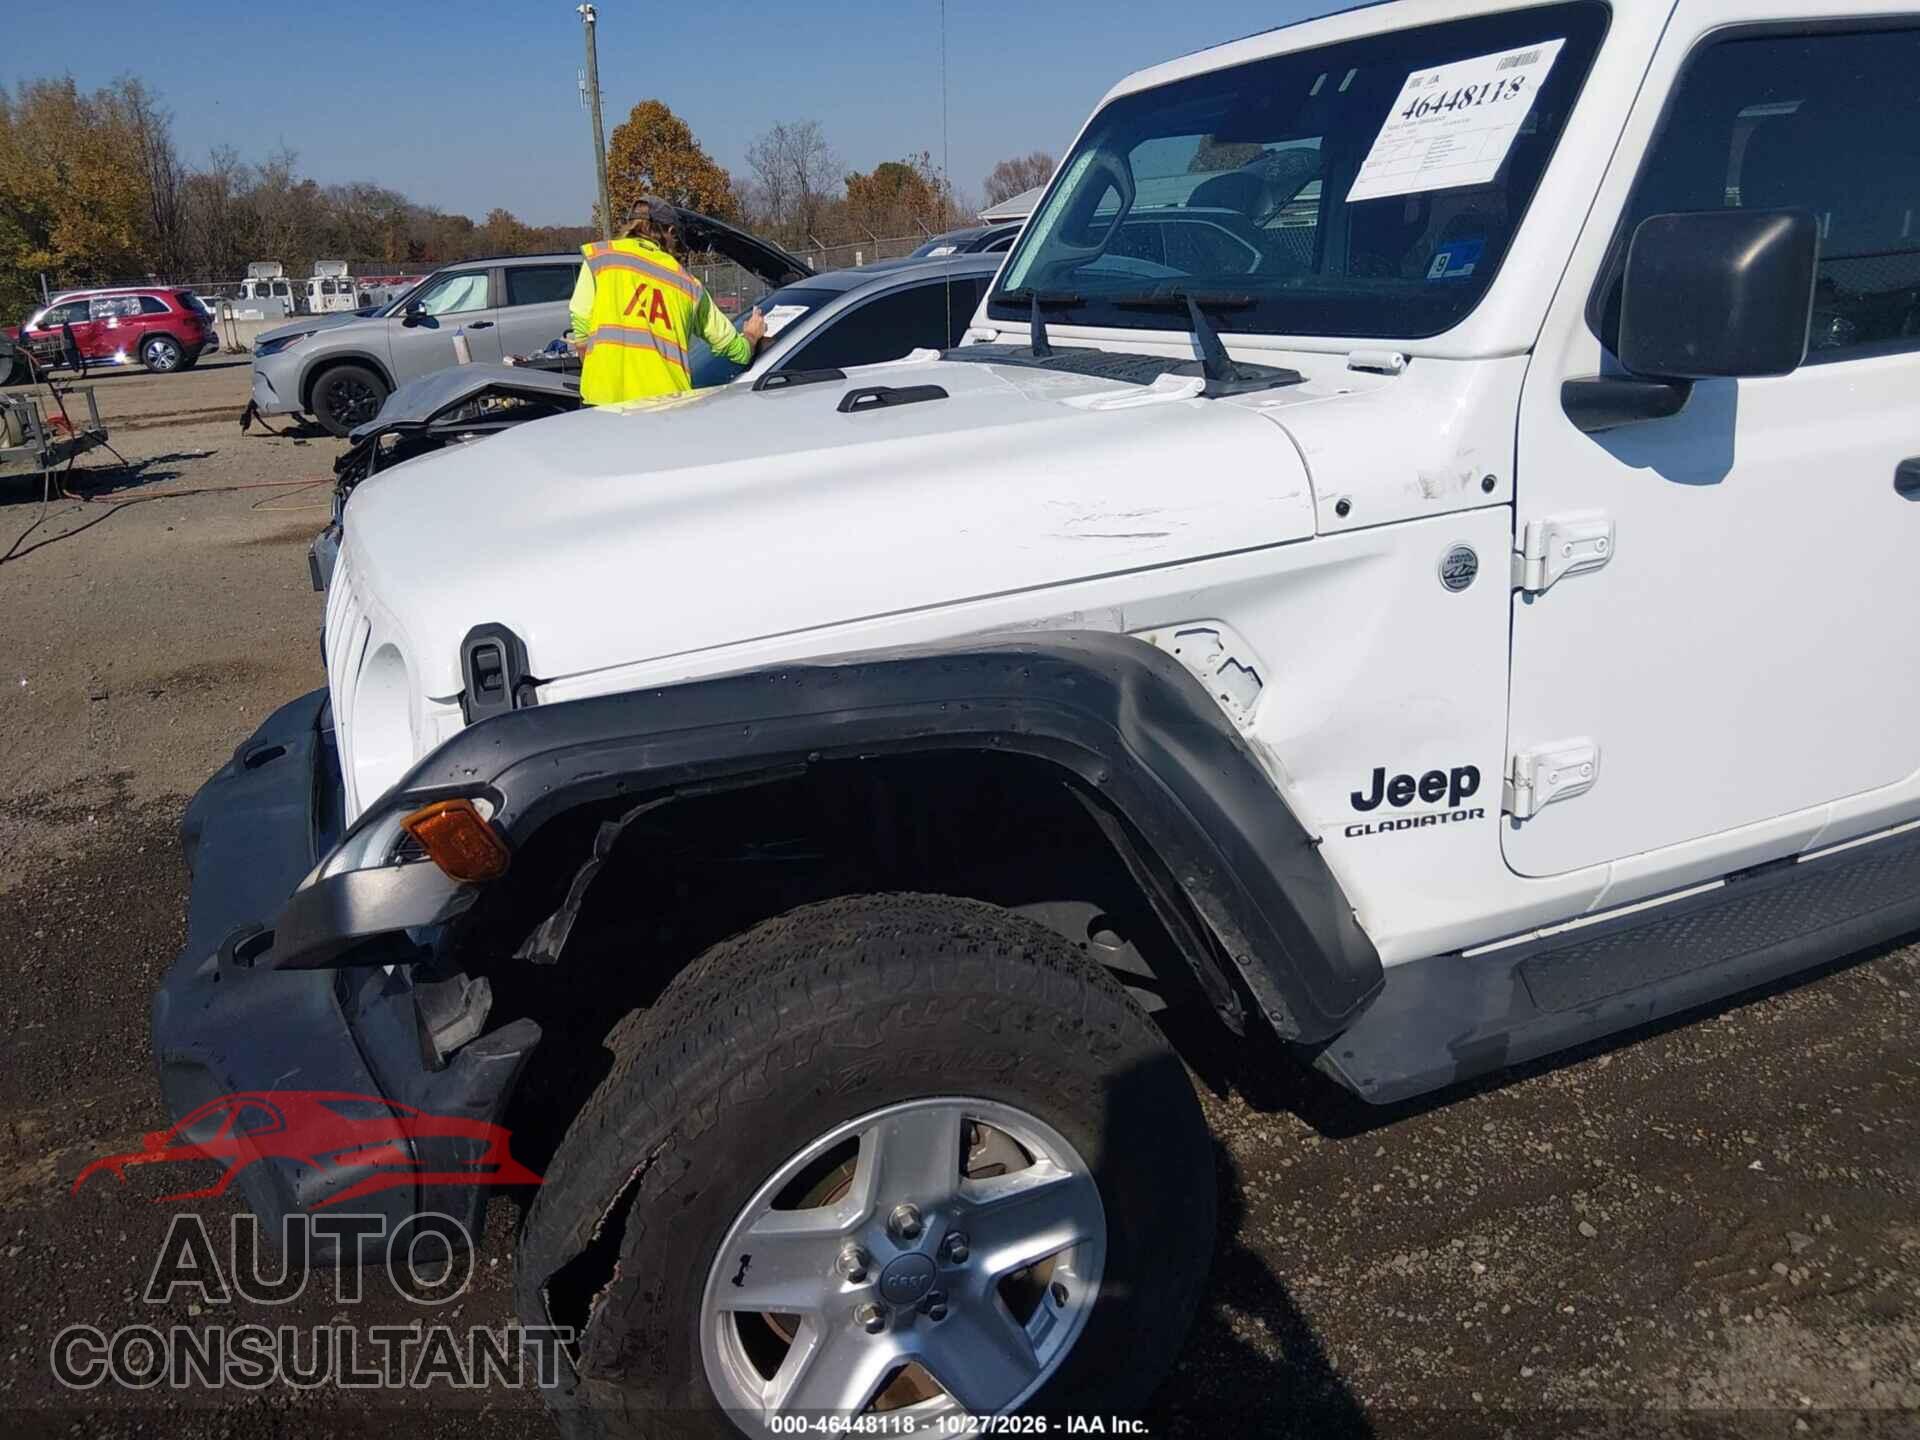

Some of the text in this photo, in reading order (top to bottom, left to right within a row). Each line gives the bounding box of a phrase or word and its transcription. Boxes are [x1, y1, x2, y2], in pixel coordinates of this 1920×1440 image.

[1402, 75, 1526, 120] 46448118
[1350, 764, 1481, 812] Jeep
[1344, 807, 1486, 838] GLADIATOR
